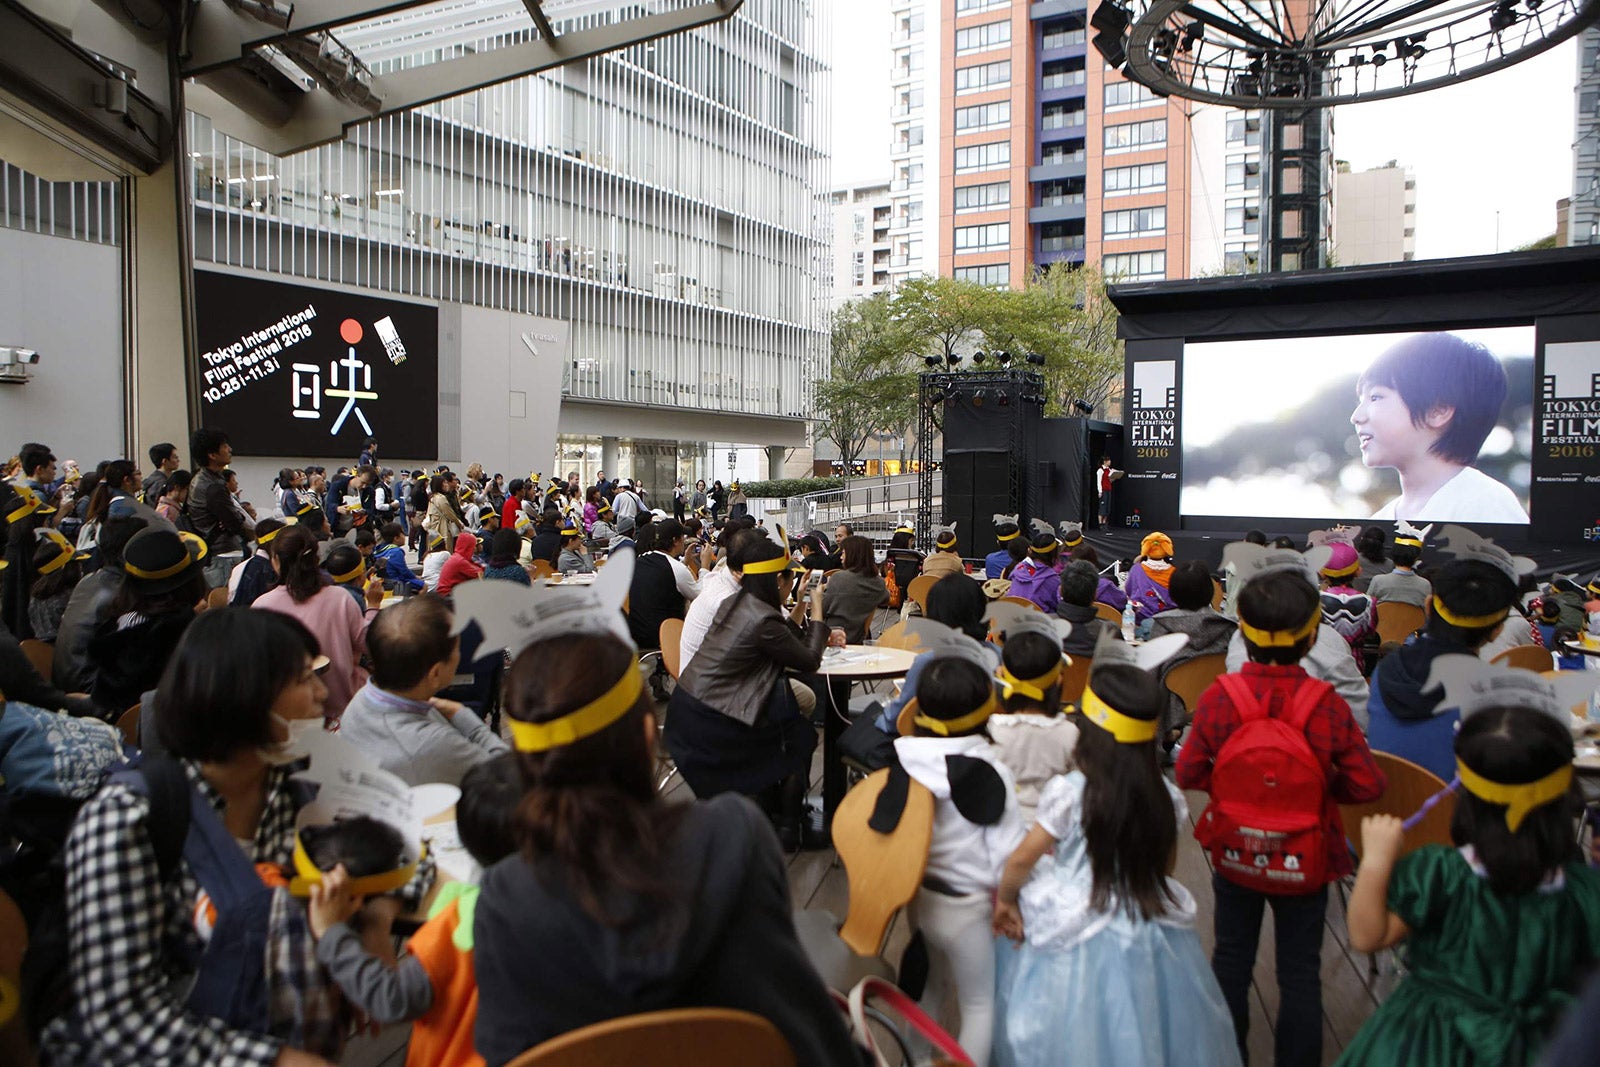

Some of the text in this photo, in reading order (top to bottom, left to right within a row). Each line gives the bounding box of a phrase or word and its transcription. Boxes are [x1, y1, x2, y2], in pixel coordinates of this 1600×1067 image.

[203, 304, 317, 366] Tokyo International
[204, 324, 312, 385] Film Festival 2016
[1132, 410, 1175, 420] TOKYO
[1132, 425, 1174, 440] FILM
[1542, 418, 1600, 436] FILM
[1137, 448, 1168, 458] 2016
[1549, 445, 1595, 458] 2016
